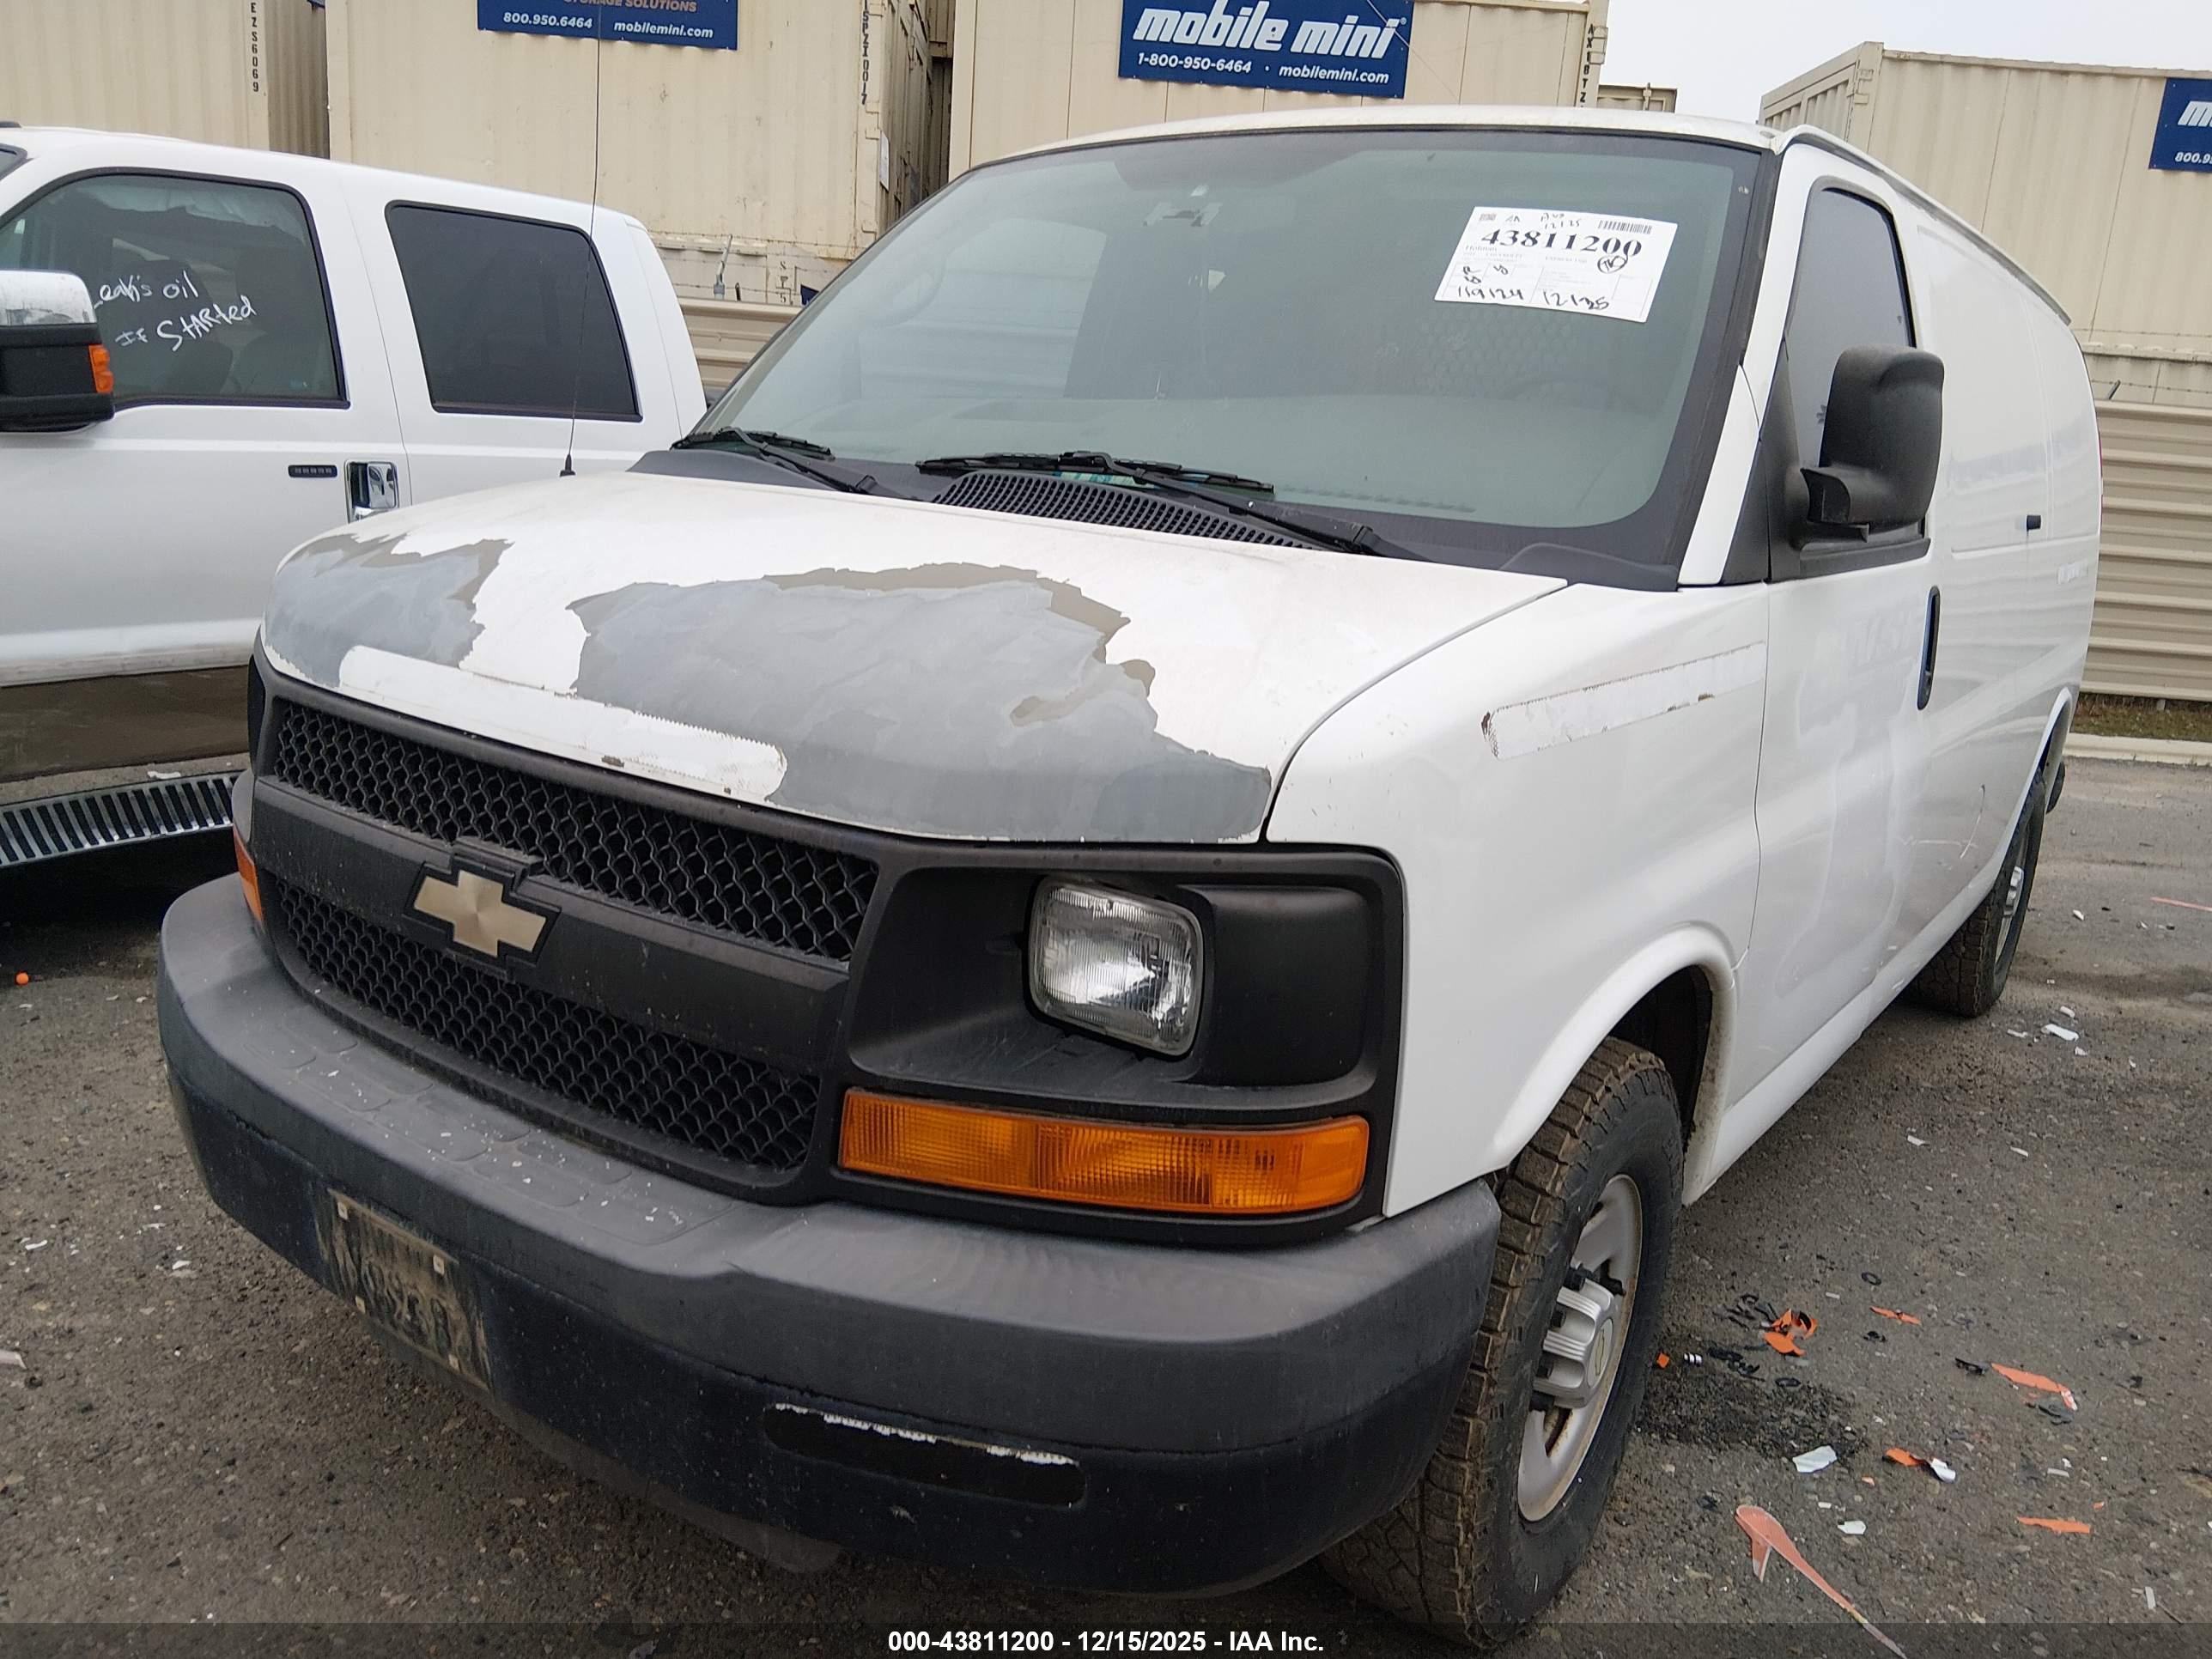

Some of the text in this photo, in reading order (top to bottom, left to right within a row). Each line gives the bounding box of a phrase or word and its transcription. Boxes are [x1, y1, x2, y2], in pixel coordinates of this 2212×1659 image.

[503, 12, 714, 39] 800.950.6464 mobilemini.com
[1133, 0, 1289, 51] mobile
[1137, 52, 1389, 83] 1-800-950-6464 mobilemini.com
[1480, 228, 1642, 257] 43811200
[163, 270, 199, 299] oil
